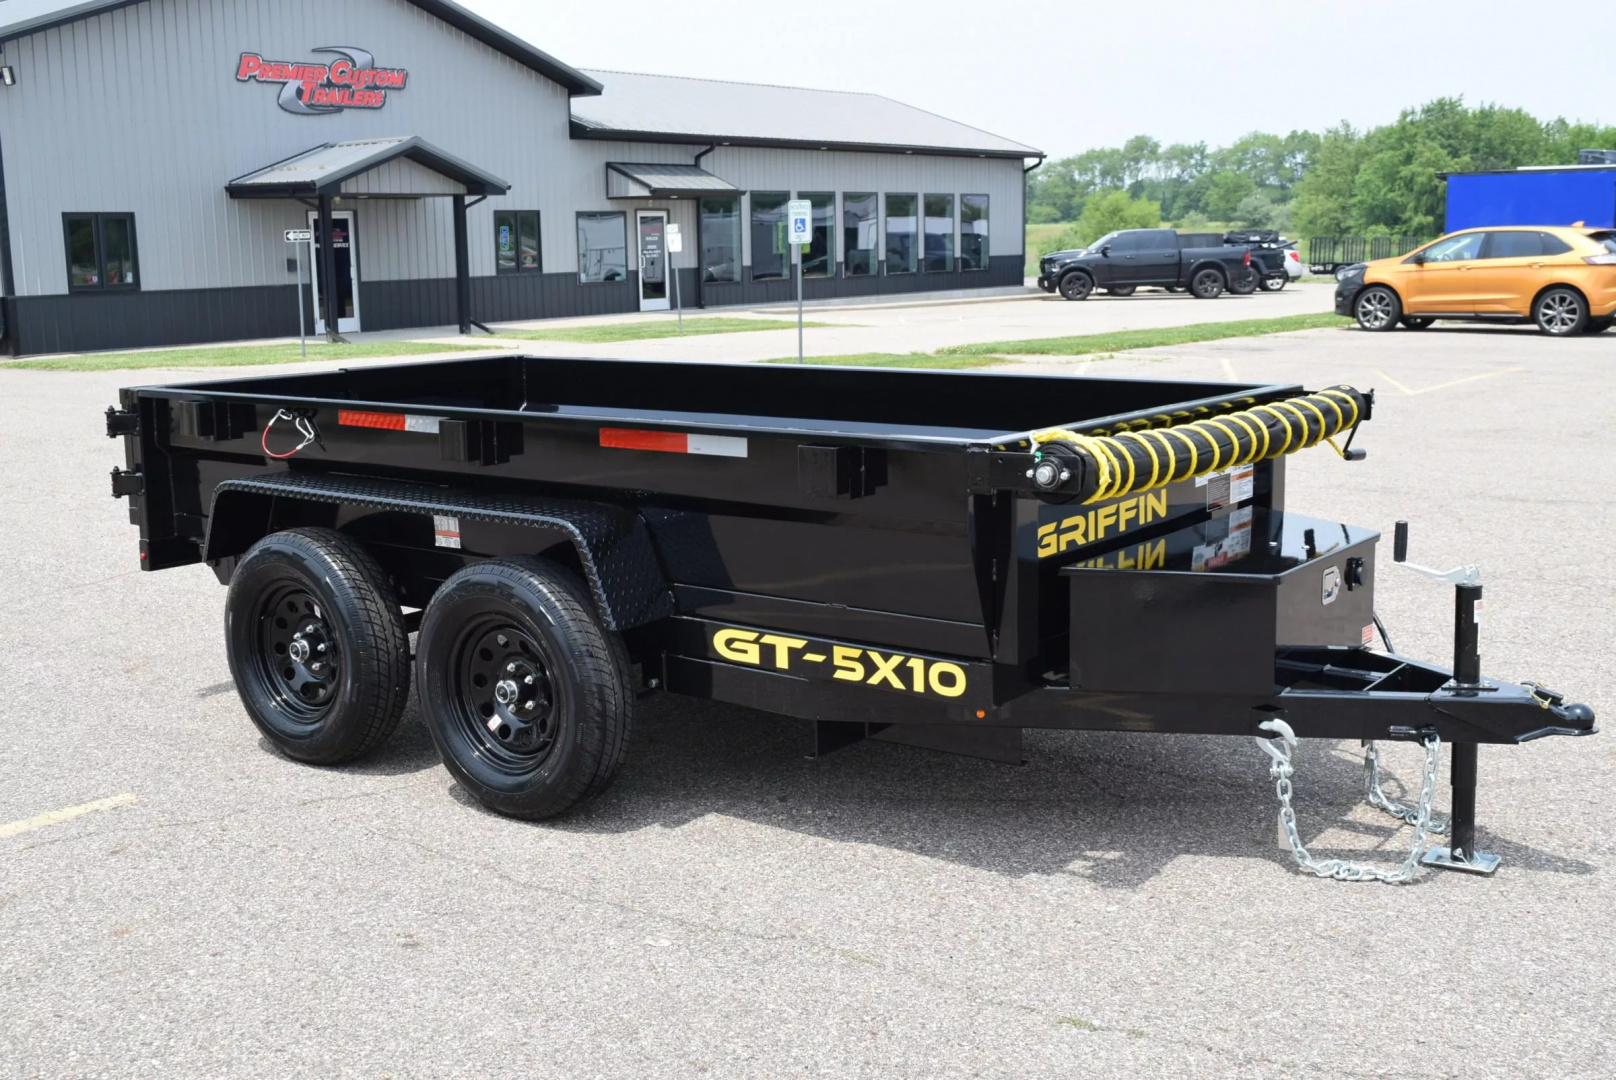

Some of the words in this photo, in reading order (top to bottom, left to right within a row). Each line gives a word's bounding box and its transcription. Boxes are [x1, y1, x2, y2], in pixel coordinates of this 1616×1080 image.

[237, 54, 327, 83] PREMIER
[329, 60, 406, 88] CUSTOM
[300, 82, 385, 106] TRAILERS
[1037, 488, 1167, 558] GRIFFIN
[713, 628, 967, 698] GT-5X10
